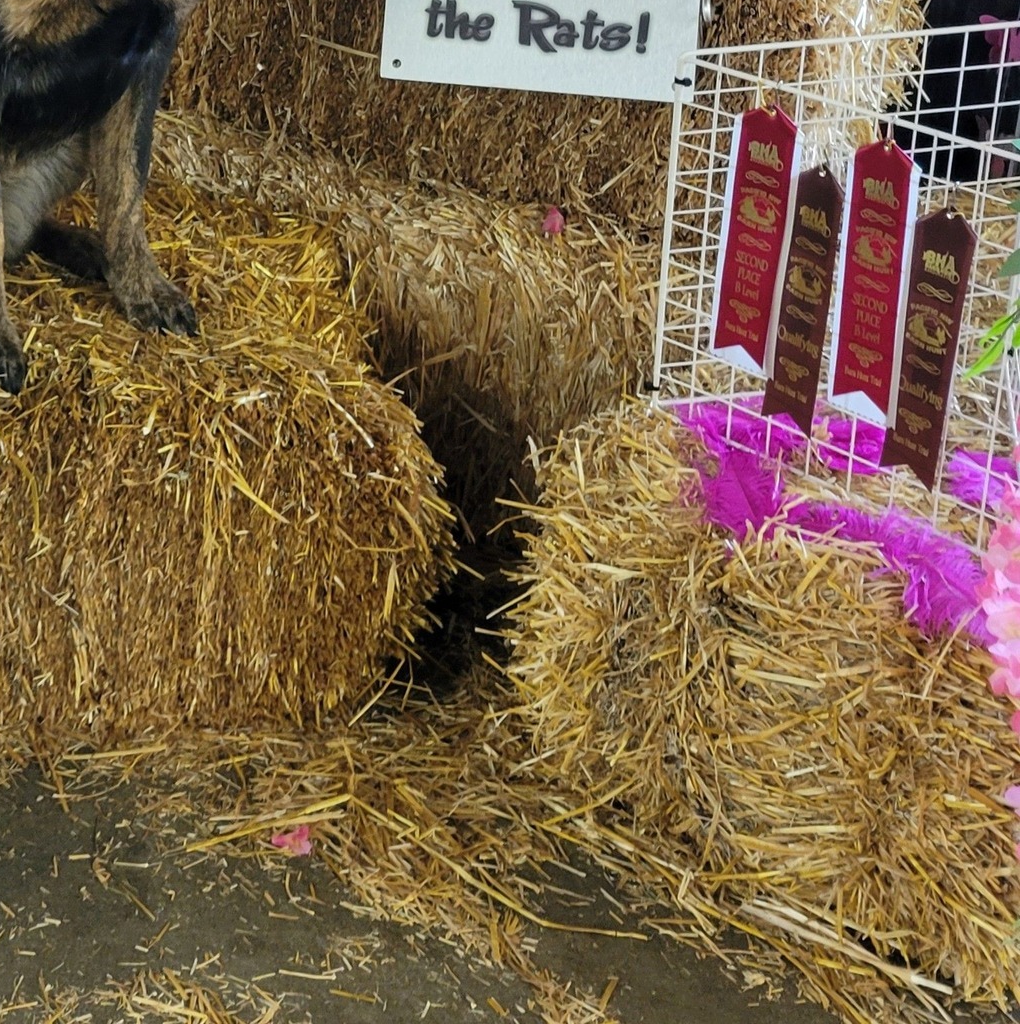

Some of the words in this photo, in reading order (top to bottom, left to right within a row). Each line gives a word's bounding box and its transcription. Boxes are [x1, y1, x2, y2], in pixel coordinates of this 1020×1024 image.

[512, 0, 651, 55] Rats!
[735, 250, 769, 272] SECOND
[851, 292, 888, 314] SECOND
